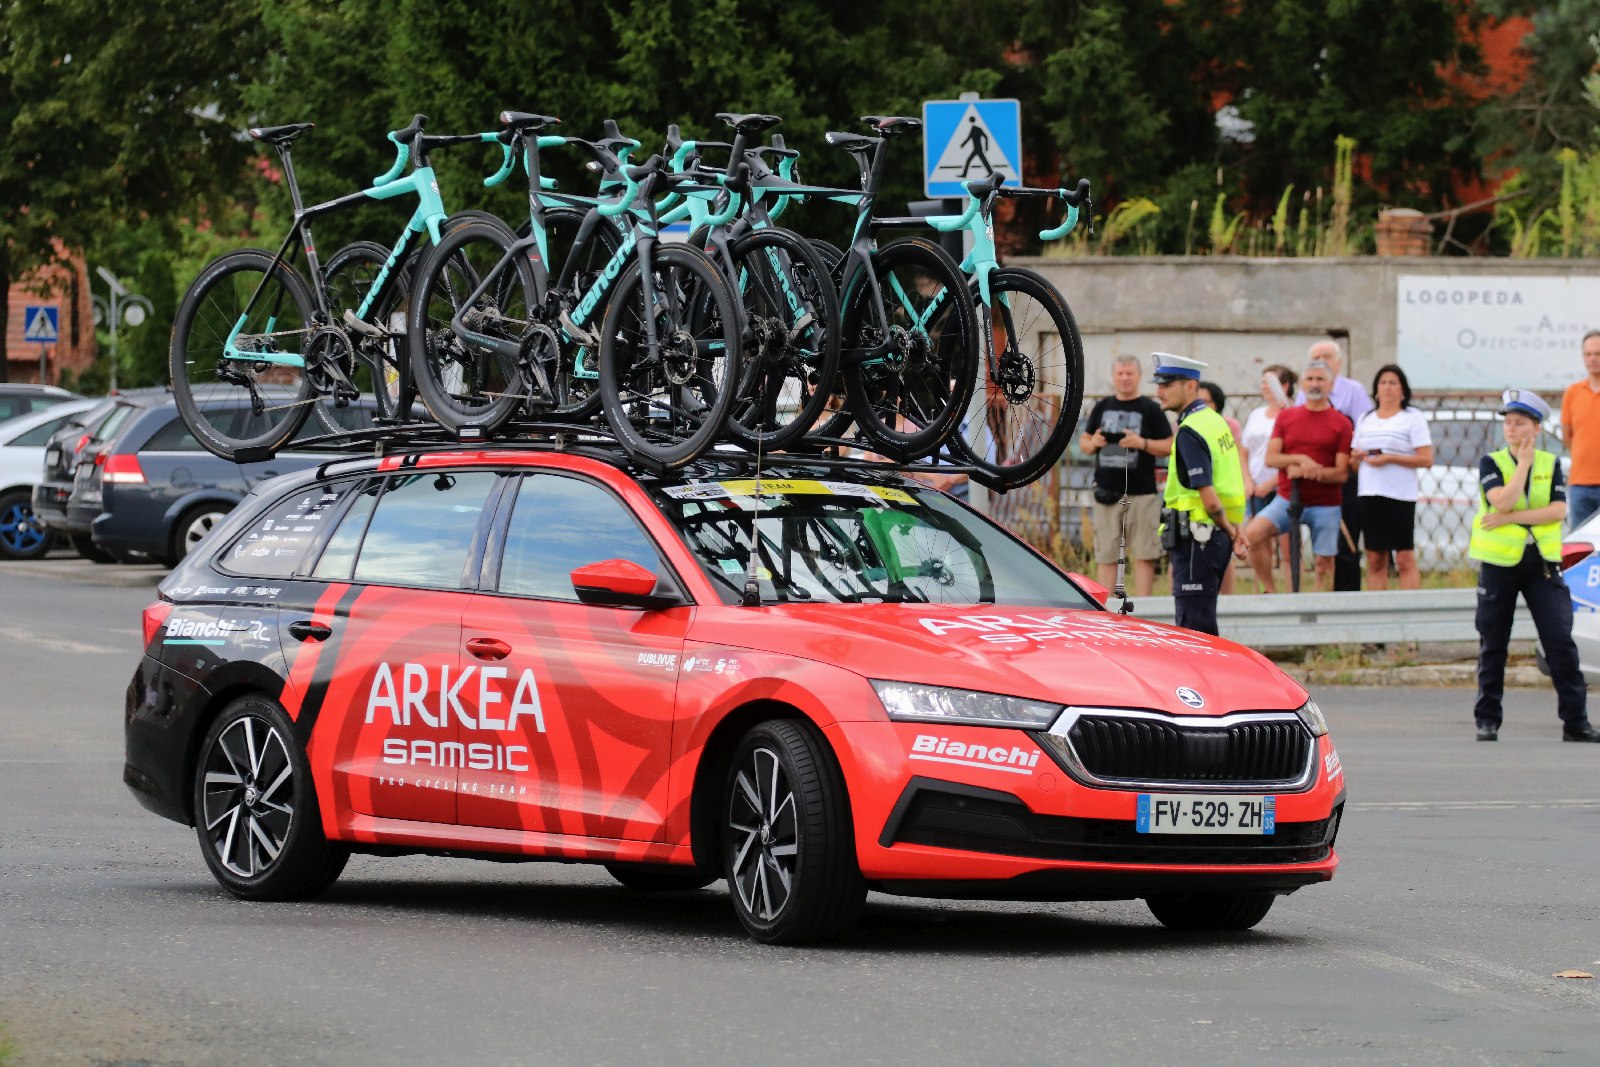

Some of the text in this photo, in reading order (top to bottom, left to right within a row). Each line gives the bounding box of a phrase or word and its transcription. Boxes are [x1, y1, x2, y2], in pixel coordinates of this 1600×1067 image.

[1406, 290, 1524, 305] LOGOPEDA
[1457, 327, 1577, 350] ORZECHOWSK
[165, 618, 237, 638] Bianchi
[918, 614, 1211, 643] ARKEA
[638, 652, 677, 666] PUBLIVUE
[364, 662, 546, 733] ARKEA
[383, 738, 529, 772] SAMSIC
[912, 734, 1041, 768] Bianchi
[379, 776, 527, 795] PRO CYCLING TEAM
[1155, 800, 1262, 828] FV-529-ZH
[1264, 817, 1275, 830] 35
